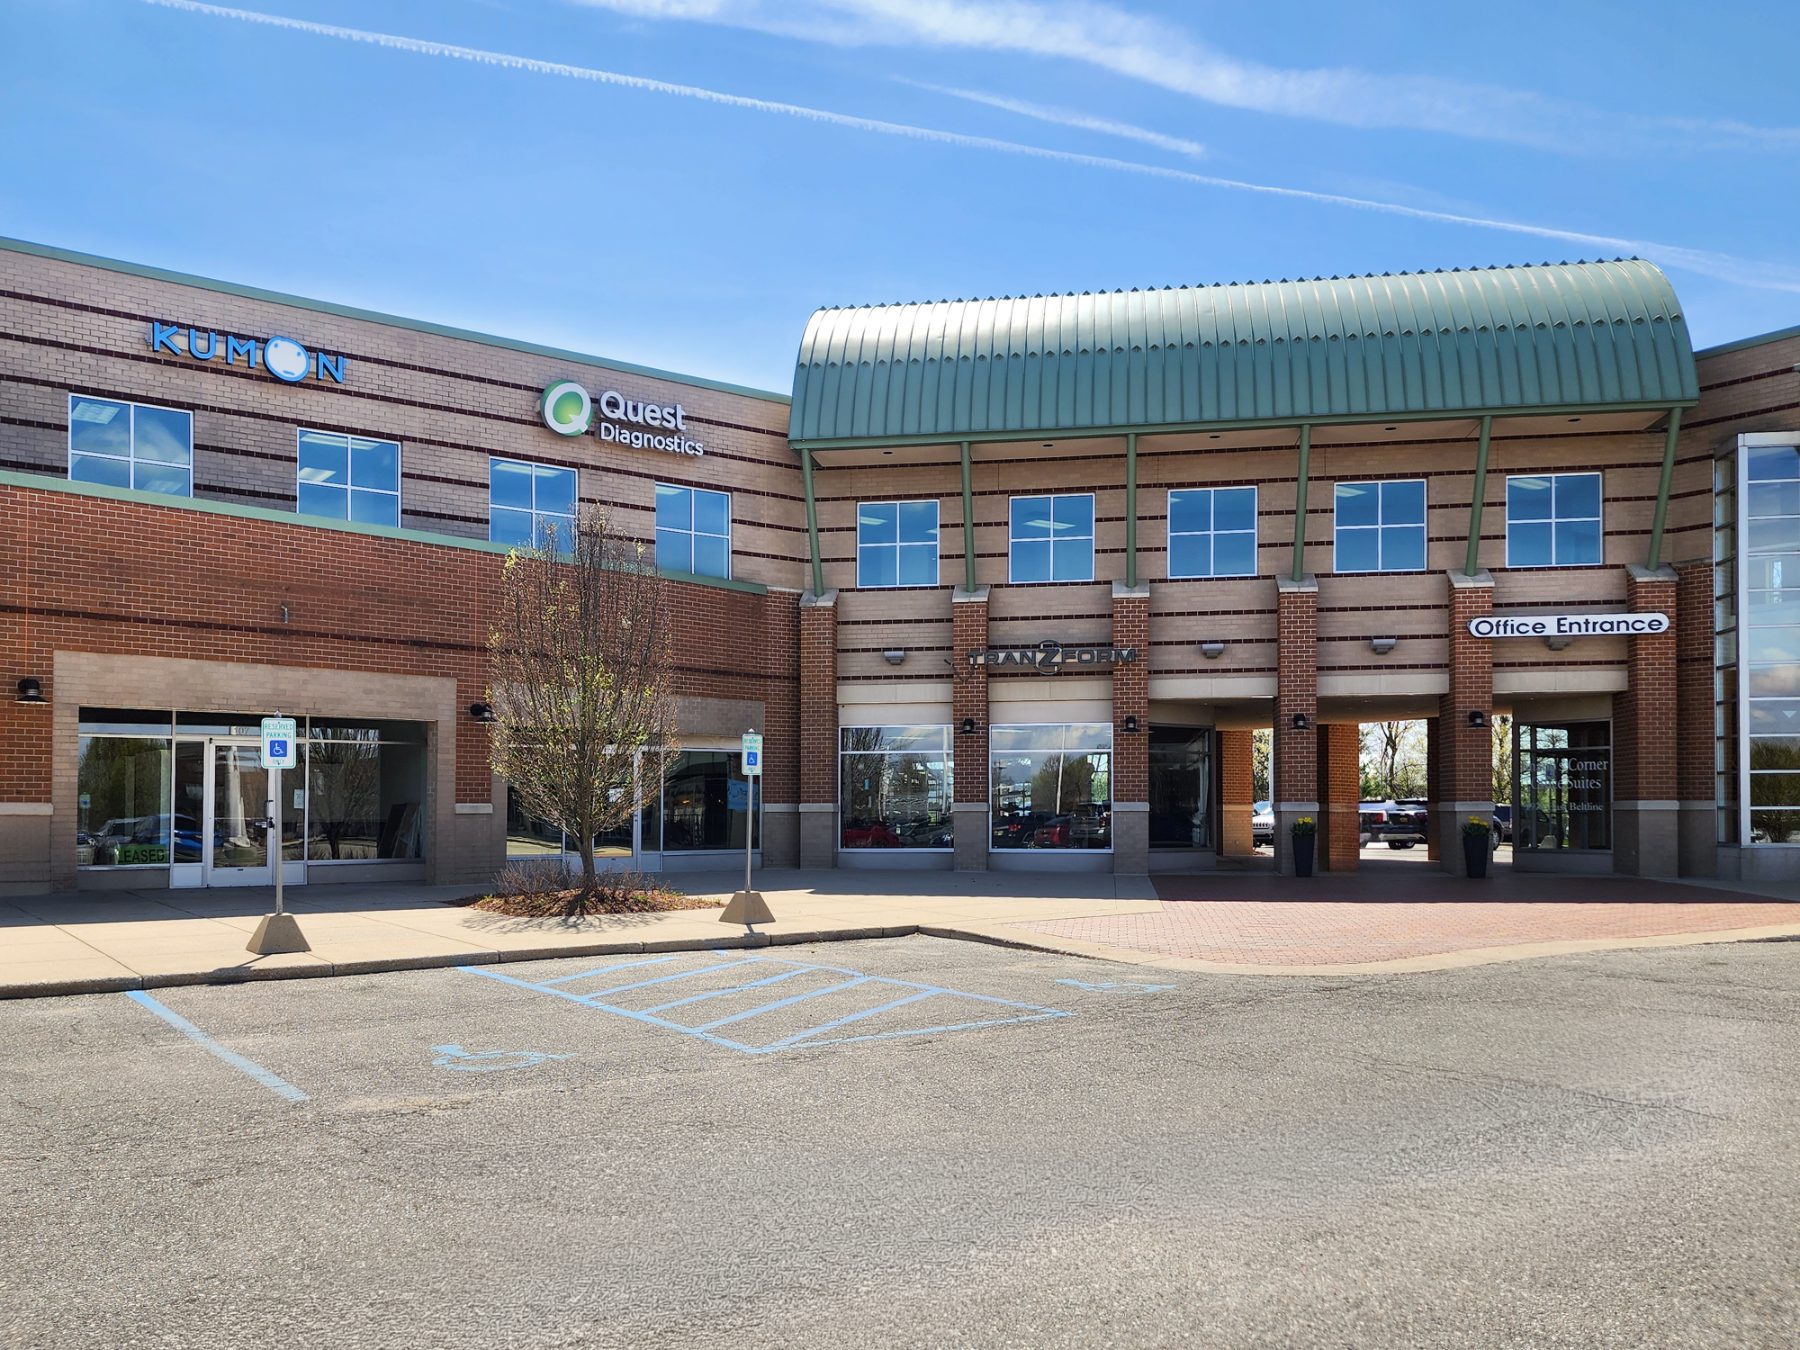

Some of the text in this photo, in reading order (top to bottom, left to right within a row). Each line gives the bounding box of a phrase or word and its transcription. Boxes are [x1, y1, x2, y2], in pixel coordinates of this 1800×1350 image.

[152, 321, 345, 384] KUMON
[600, 390, 687, 431] Quest
[600, 422, 704, 456] Diagnostics
[1474, 616, 1664, 636] Office Entrance
[264, 723, 293, 731] RESERVED
[266, 731, 292, 739] PARKING
[1568, 757, 1609, 772] Corner
[1567, 775, 1602, 789] Suites
[1569, 801, 1604, 811] Beltline
